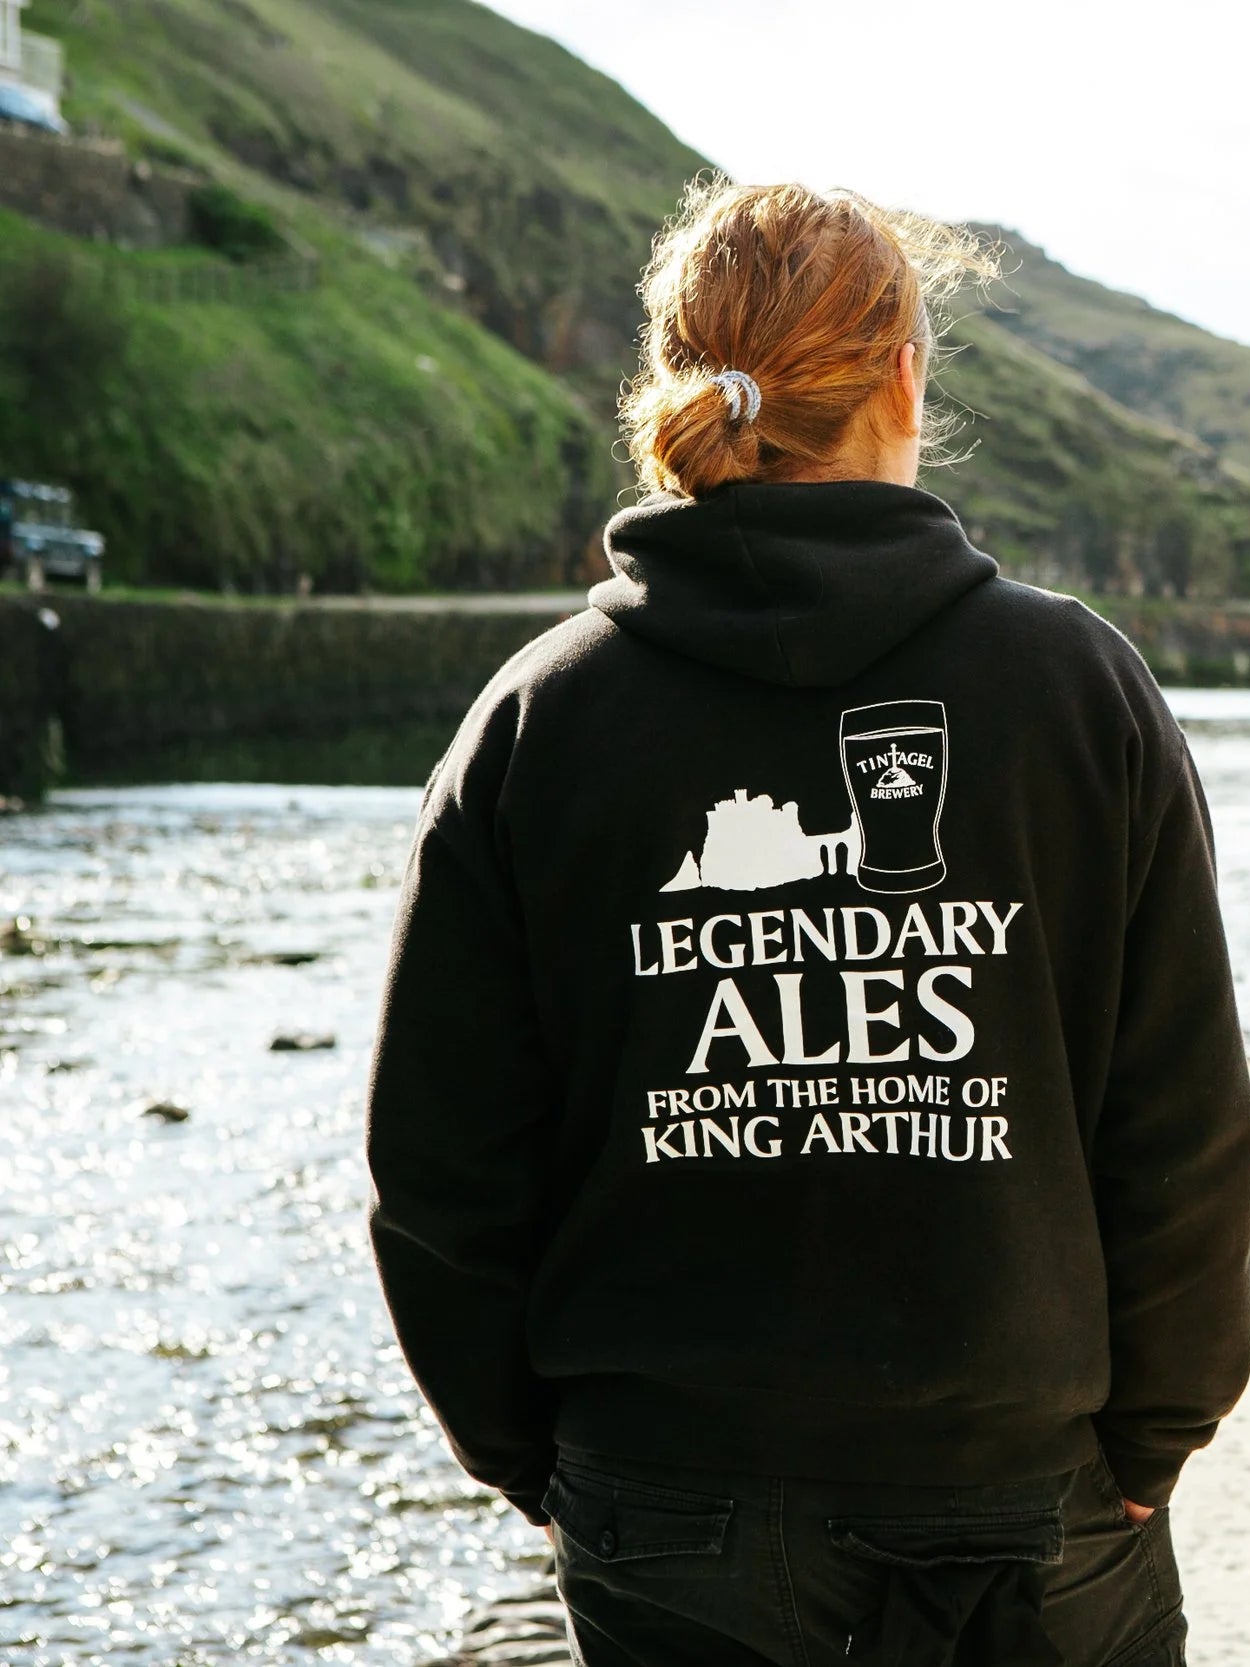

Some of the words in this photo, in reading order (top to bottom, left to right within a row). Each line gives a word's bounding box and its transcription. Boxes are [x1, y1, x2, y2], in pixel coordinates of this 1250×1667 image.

[856, 750, 934, 774] TINTAGEL
[870, 783, 924, 800] BREWERY
[630, 901, 1024, 976] LEGENDARY
[685, 965, 975, 1074] ALES
[646, 1080, 757, 1119] FROM
[766, 1078, 840, 1109] THE
[850, 1074, 951, 1106] HOME
[961, 1076, 1008, 1108] OF
[640, 1115, 783, 1164] KING
[799, 1111, 1013, 1162] ARTHUR
